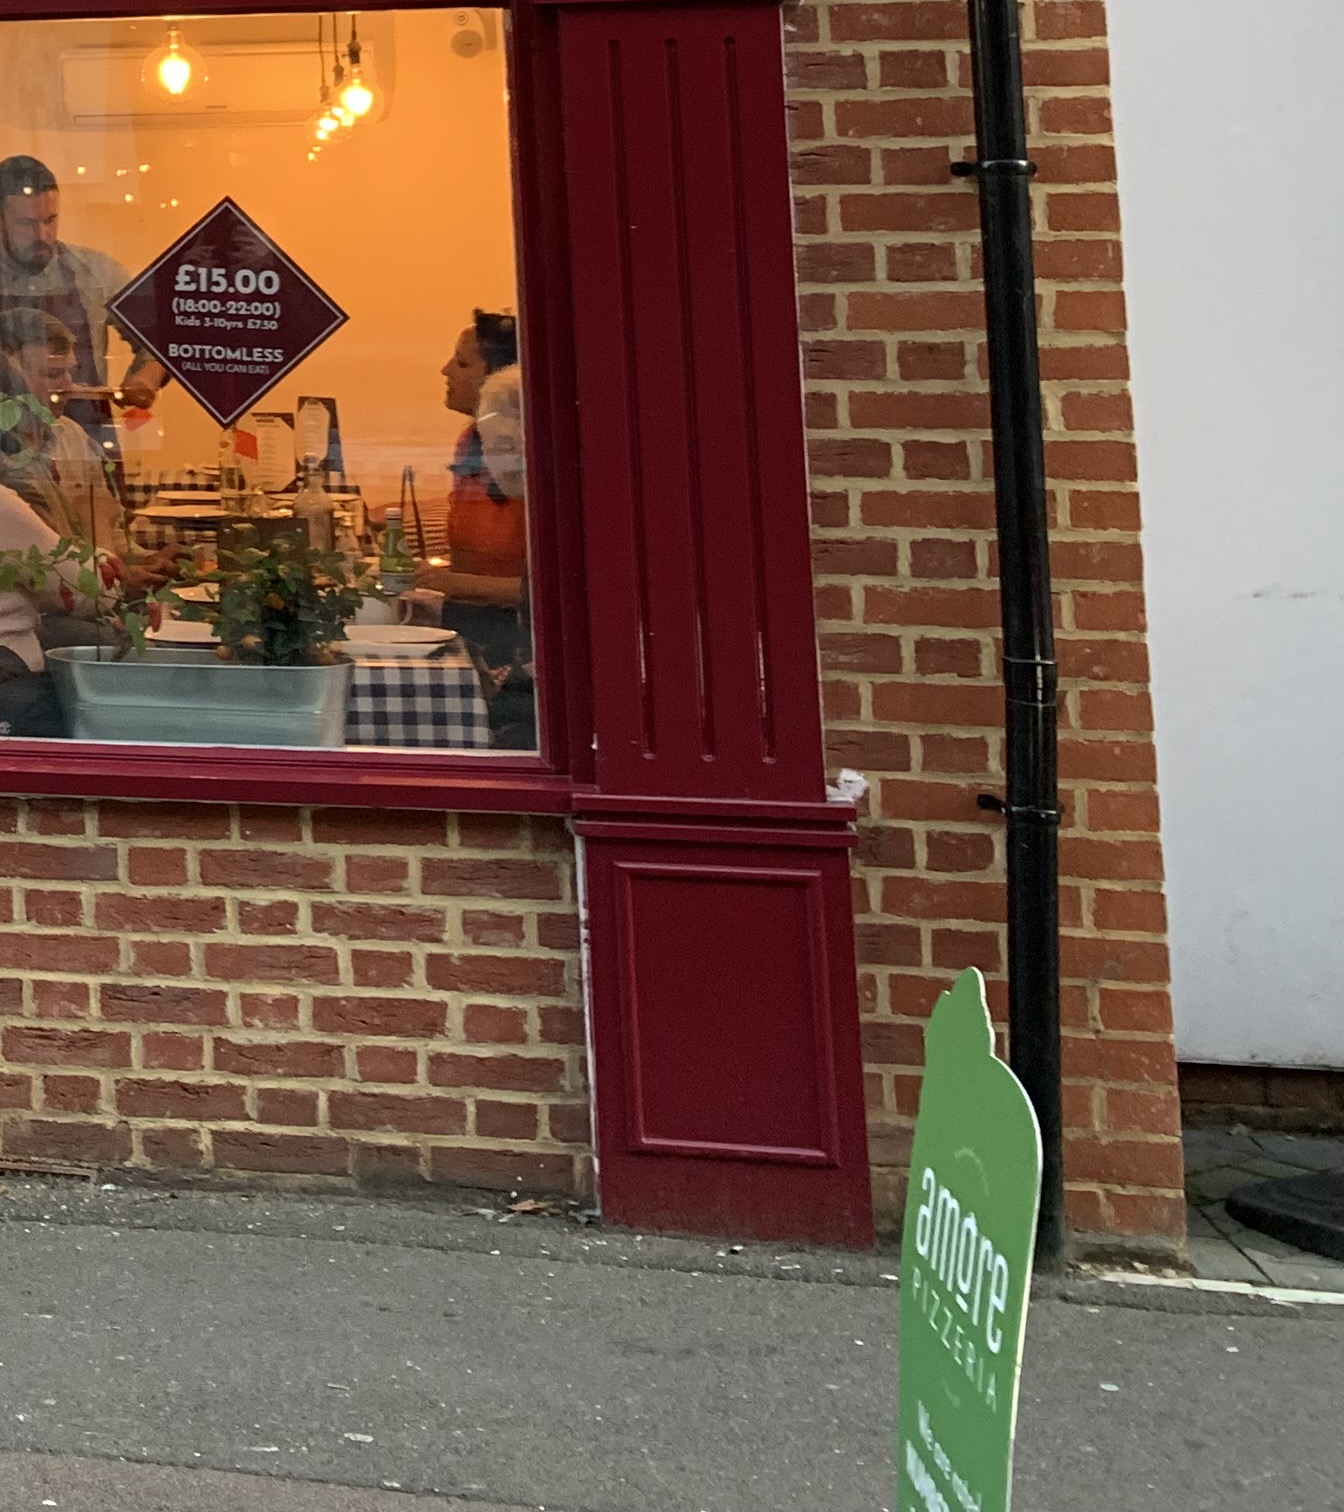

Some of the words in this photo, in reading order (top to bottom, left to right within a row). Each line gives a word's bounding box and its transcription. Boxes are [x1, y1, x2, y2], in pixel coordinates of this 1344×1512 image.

[174, 263, 280, 295] £15.00
[172, 297, 281, 319] (18:00-22:00)
[175, 315, 200, 327] Kids
[203, 317, 243, 330] 3-10yrs
[247, 318, 278, 330] £7.50
[168, 343, 284, 363] BOTTOMLESS
[181, 361, 202, 371] (ALL
[204, 362, 224, 372] YOU
[916, 1167, 1009, 1354] amore
[911, 1266, 999, 1415] PIZZERIA
